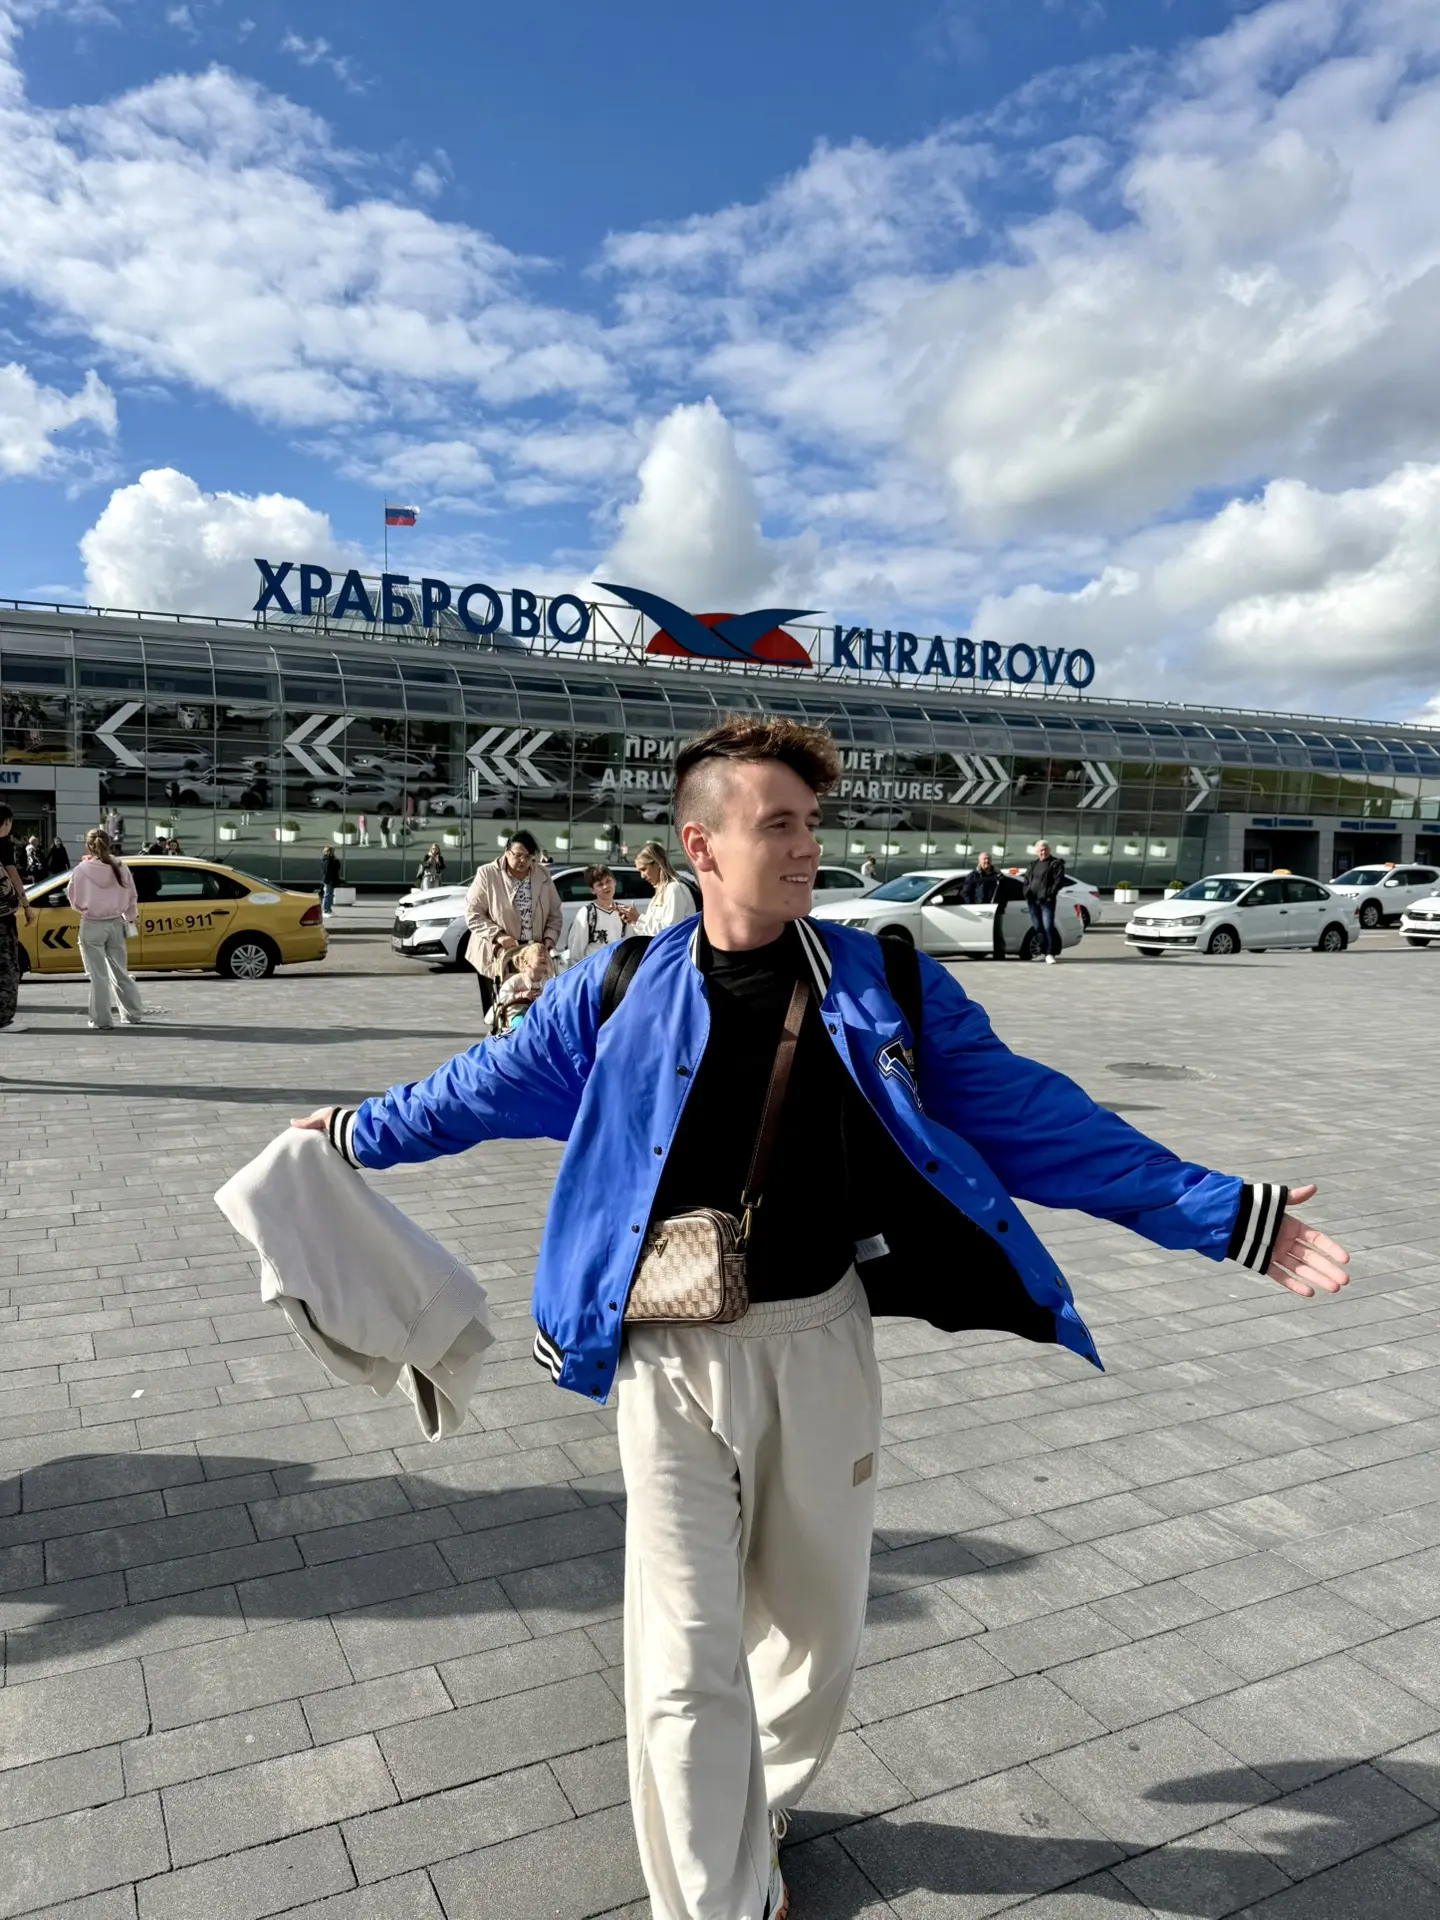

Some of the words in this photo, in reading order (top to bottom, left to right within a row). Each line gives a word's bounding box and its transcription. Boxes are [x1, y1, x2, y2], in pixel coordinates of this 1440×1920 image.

[252, 558, 591, 644] ХРАБРОВО
[833, 625, 1096, 689] KHRABROVO
[601, 768, 678, 790] ARRIV
[817, 779, 944, 800] PARTURES
[145, 917, 173, 933] 911
[185, 913, 213, 929] 911
